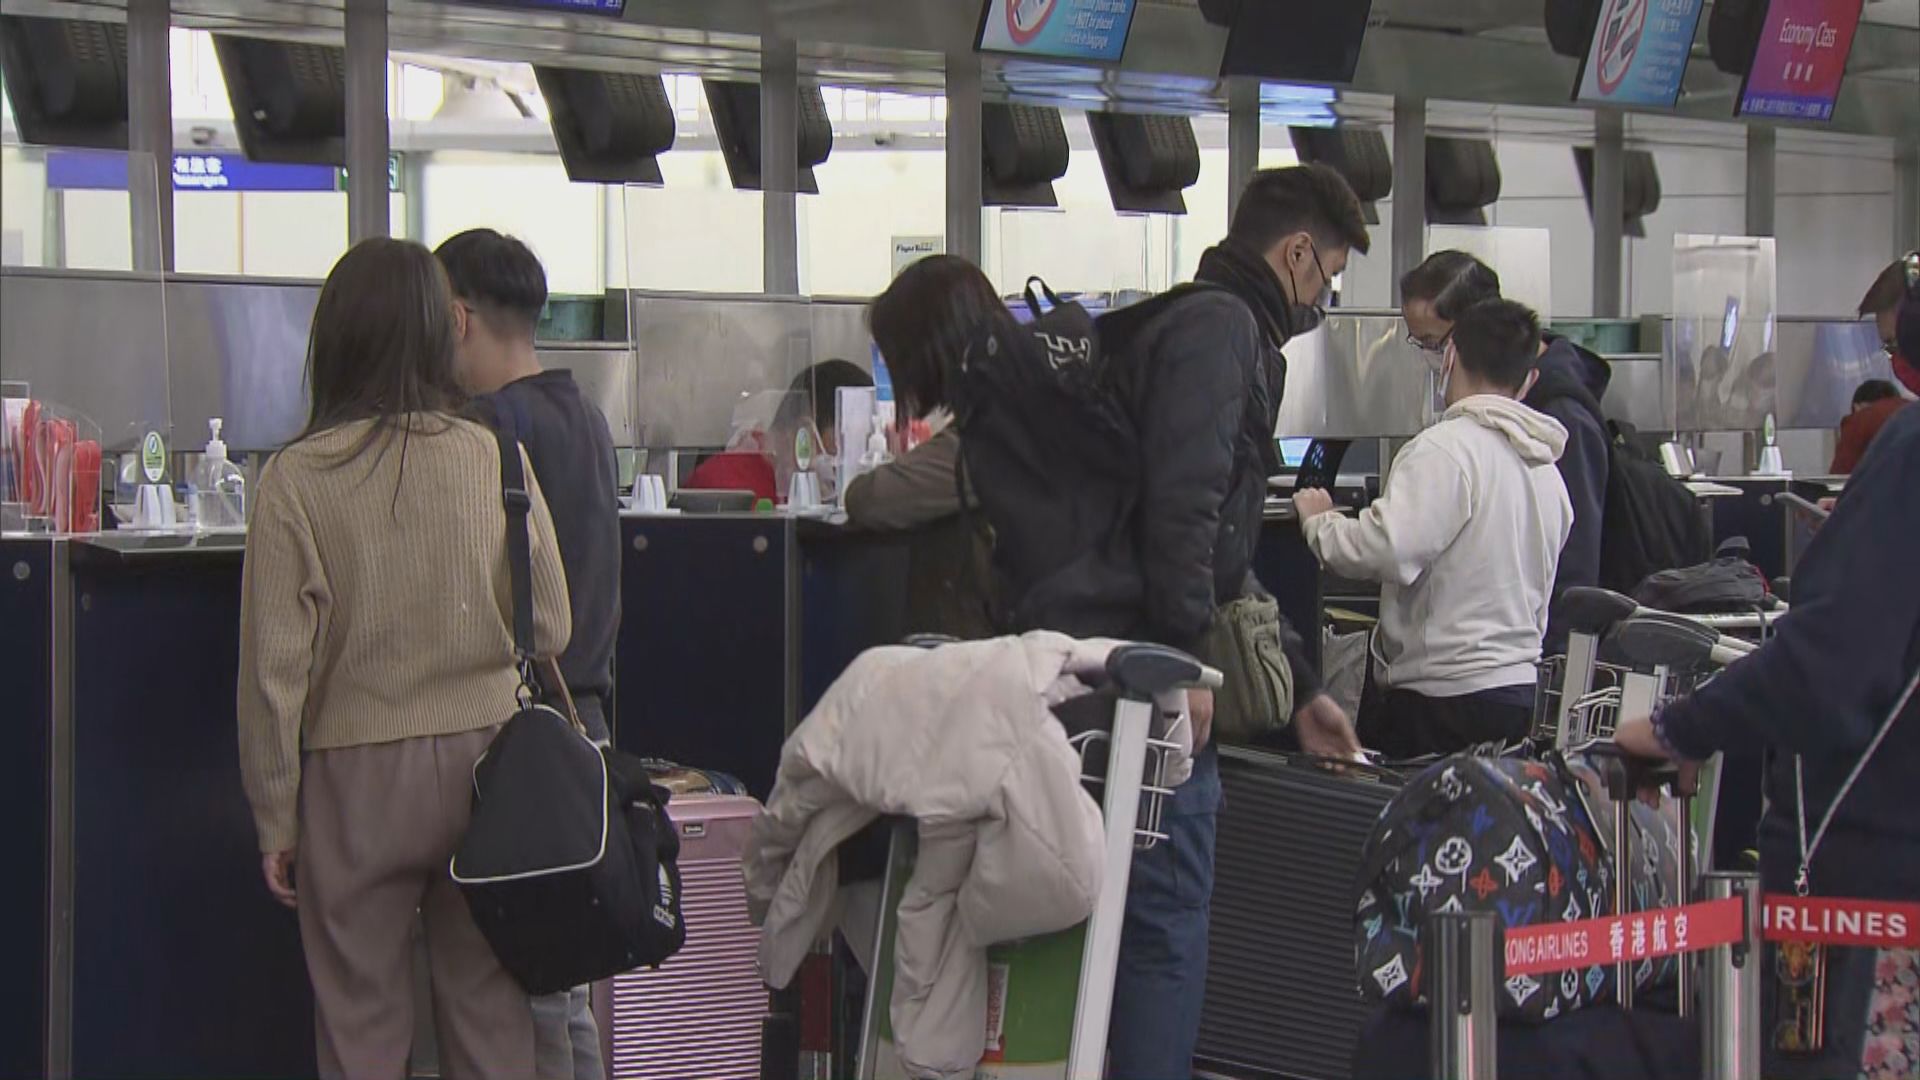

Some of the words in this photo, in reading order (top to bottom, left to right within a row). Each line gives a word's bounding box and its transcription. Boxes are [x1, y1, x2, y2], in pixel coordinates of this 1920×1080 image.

[1779, 18, 1816, 53] Economy
[1816, 21, 1837, 48] Class
[1536, 931, 1588, 963] AIRLINES
[1610, 912, 1688, 959] 香港航空
